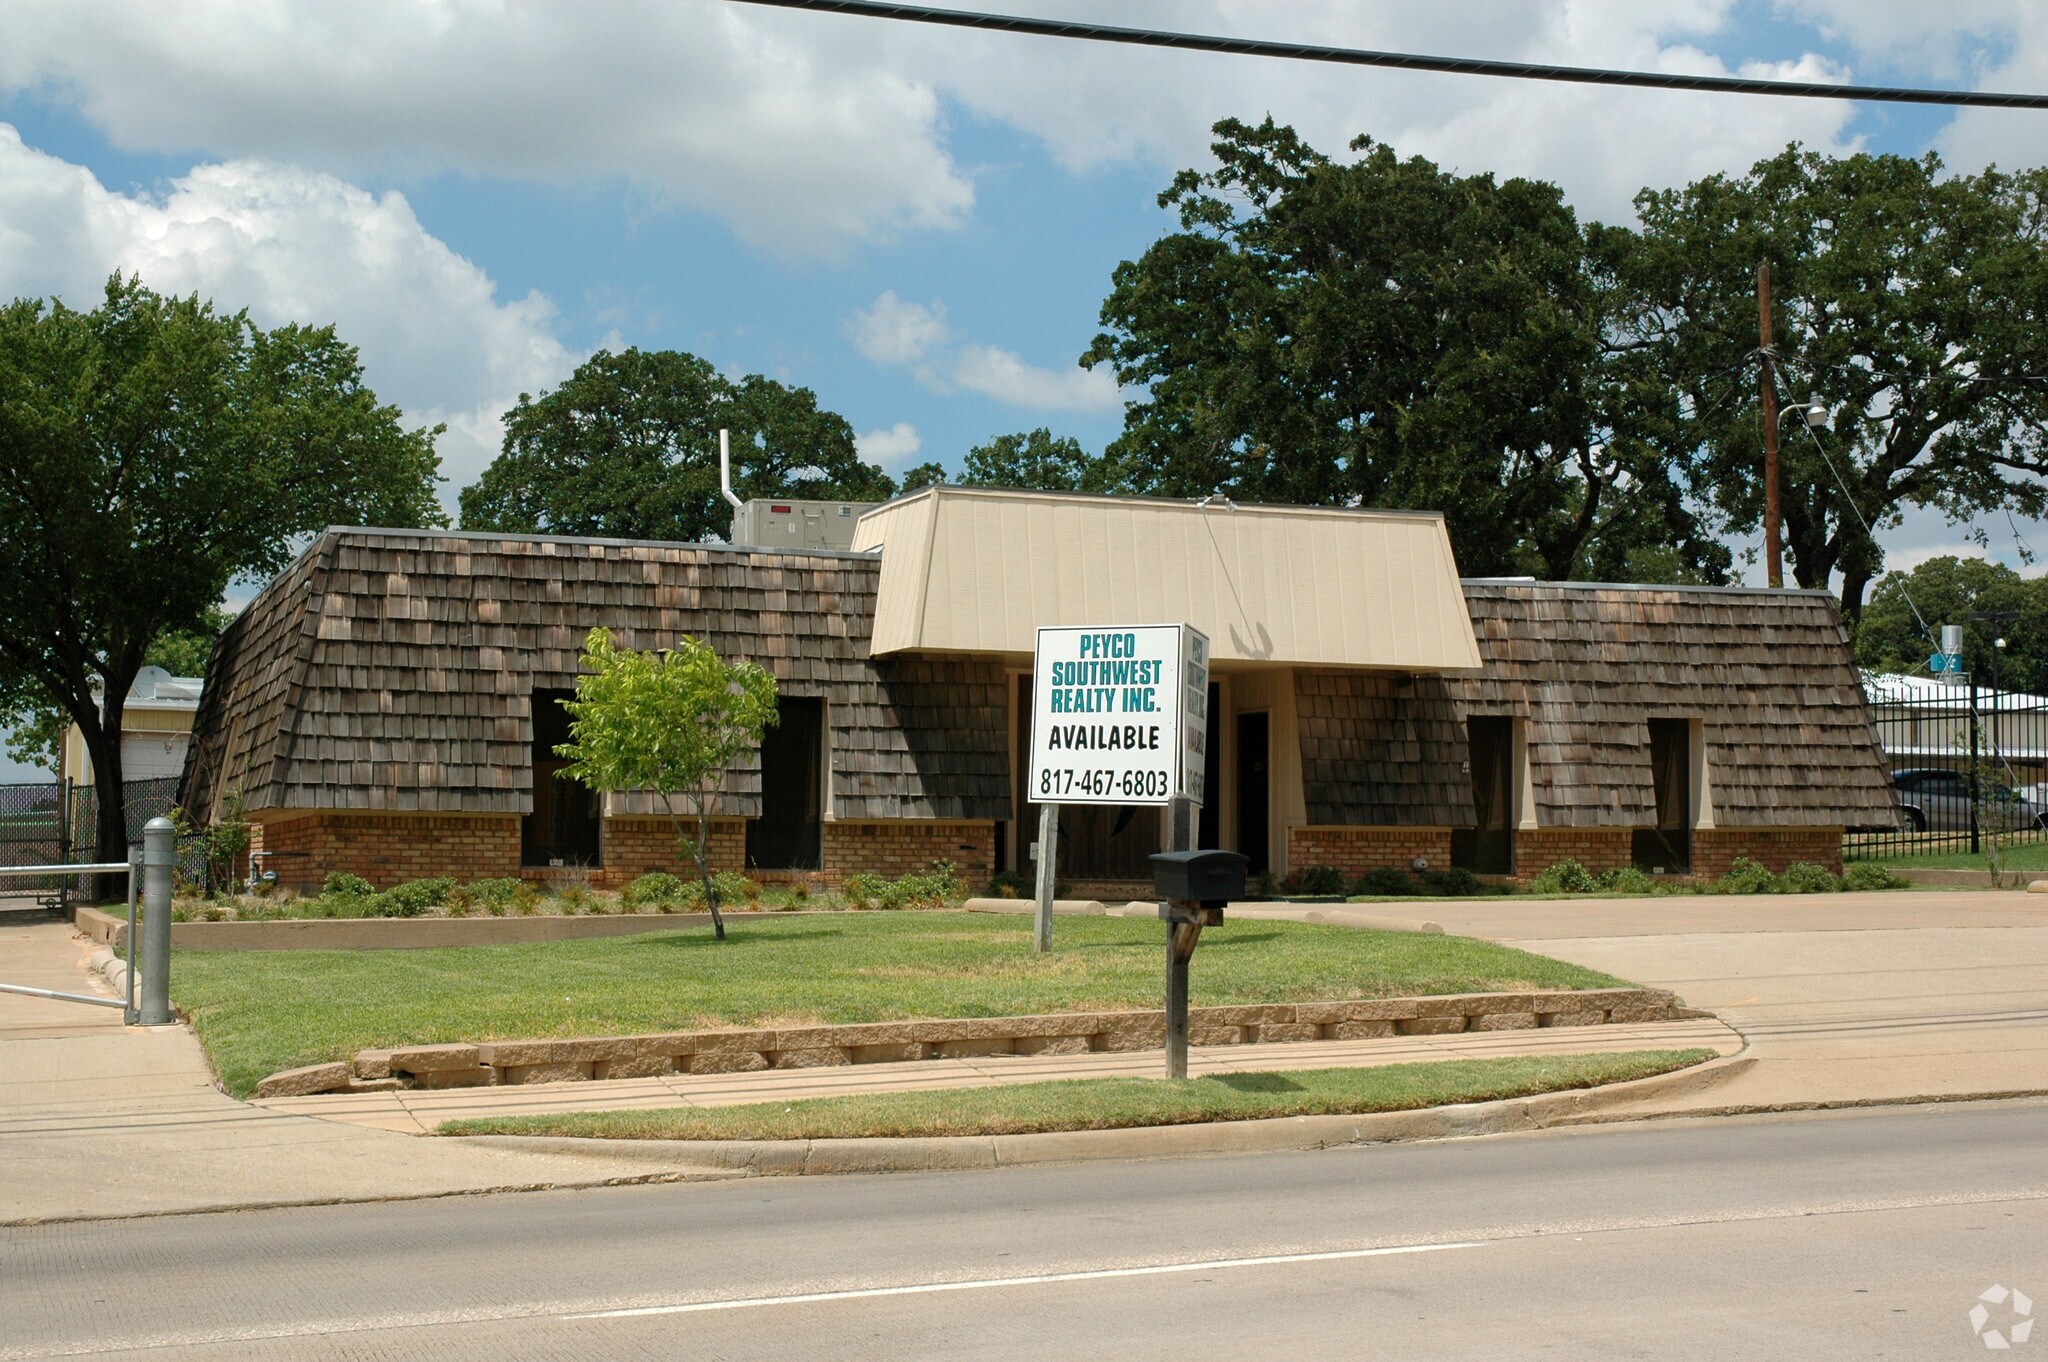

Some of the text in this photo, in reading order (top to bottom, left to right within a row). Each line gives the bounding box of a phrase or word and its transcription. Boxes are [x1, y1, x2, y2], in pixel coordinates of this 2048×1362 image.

[1080, 633, 1135, 658] PEYCO
[1052, 660, 1162, 686] SOUTHWEST
[1051, 688, 1116, 713] REALTY
[1122, 687, 1161, 712] INC.
[1049, 725, 1160, 751] AVAILABLE
[1041, 768, 1167, 796] 817-467-6803
